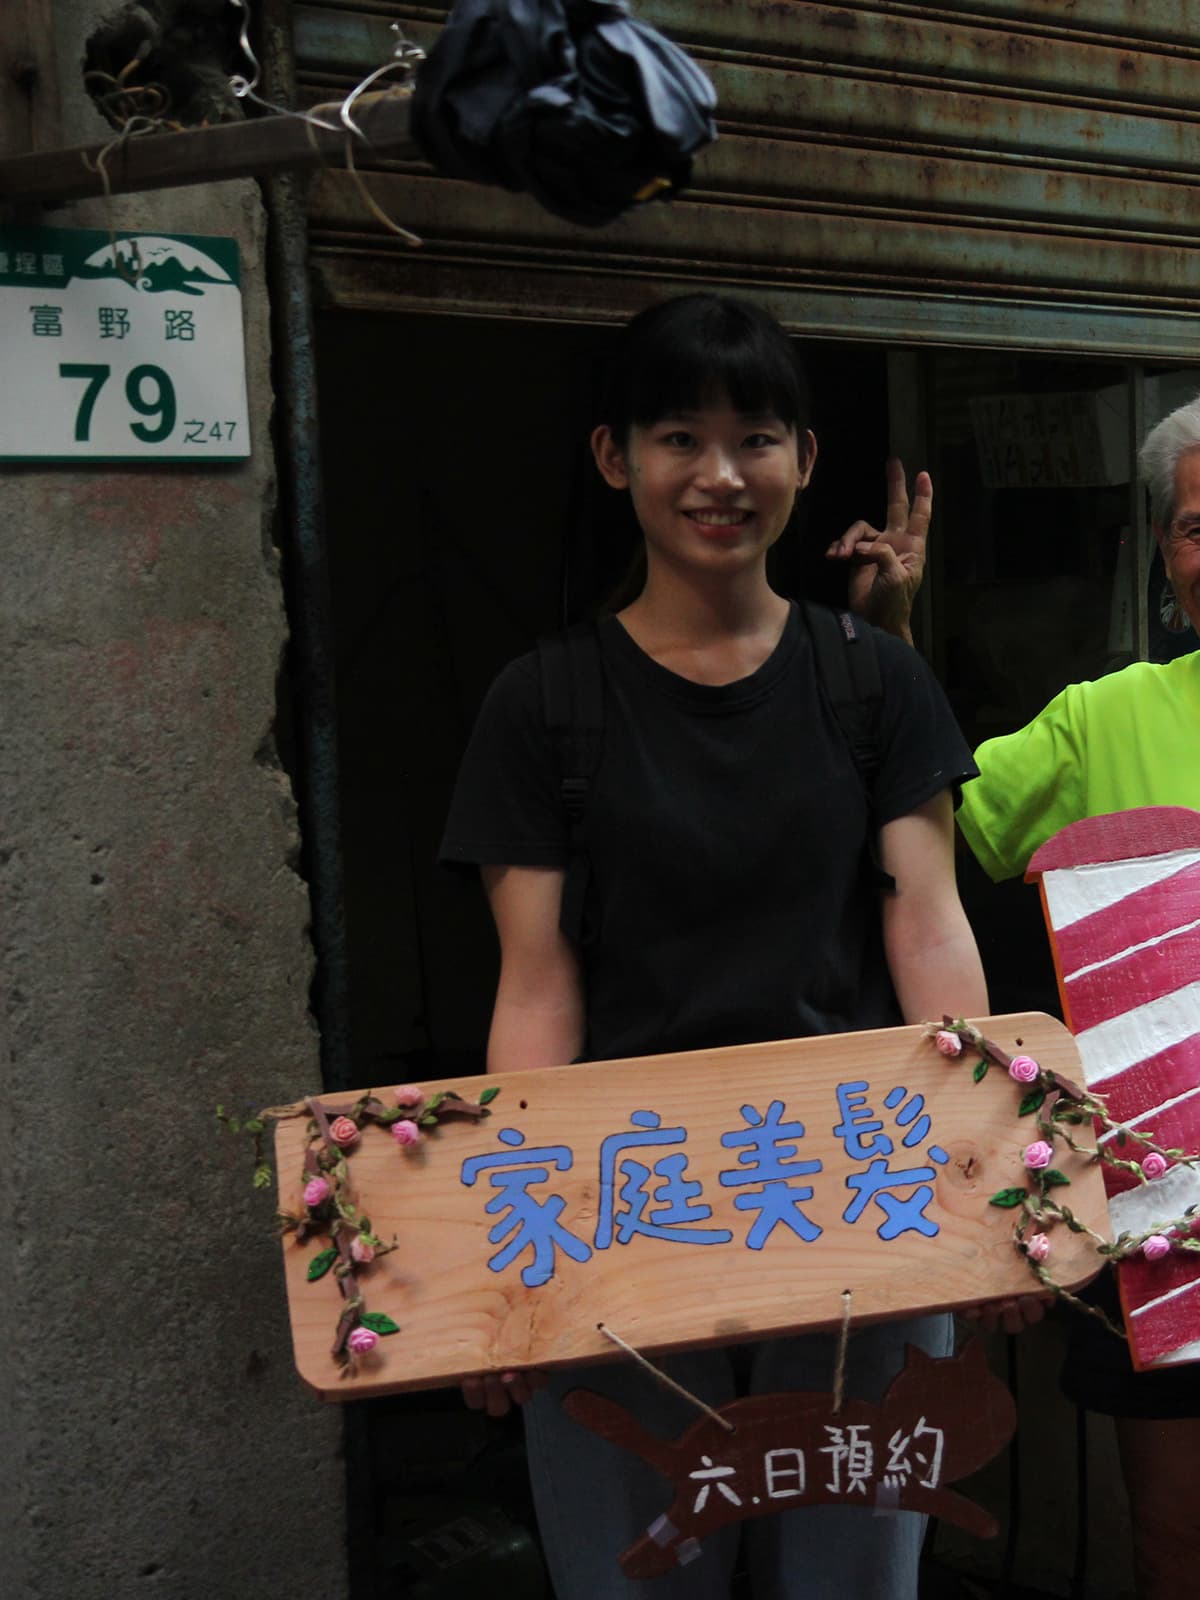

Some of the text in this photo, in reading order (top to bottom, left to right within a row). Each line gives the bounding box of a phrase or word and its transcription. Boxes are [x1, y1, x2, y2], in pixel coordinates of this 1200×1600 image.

[30, 304, 196, 341] 富野路
[59, 362, 237, 444] 79 之47
[461, 1081, 949, 1287] 家庭美髮
